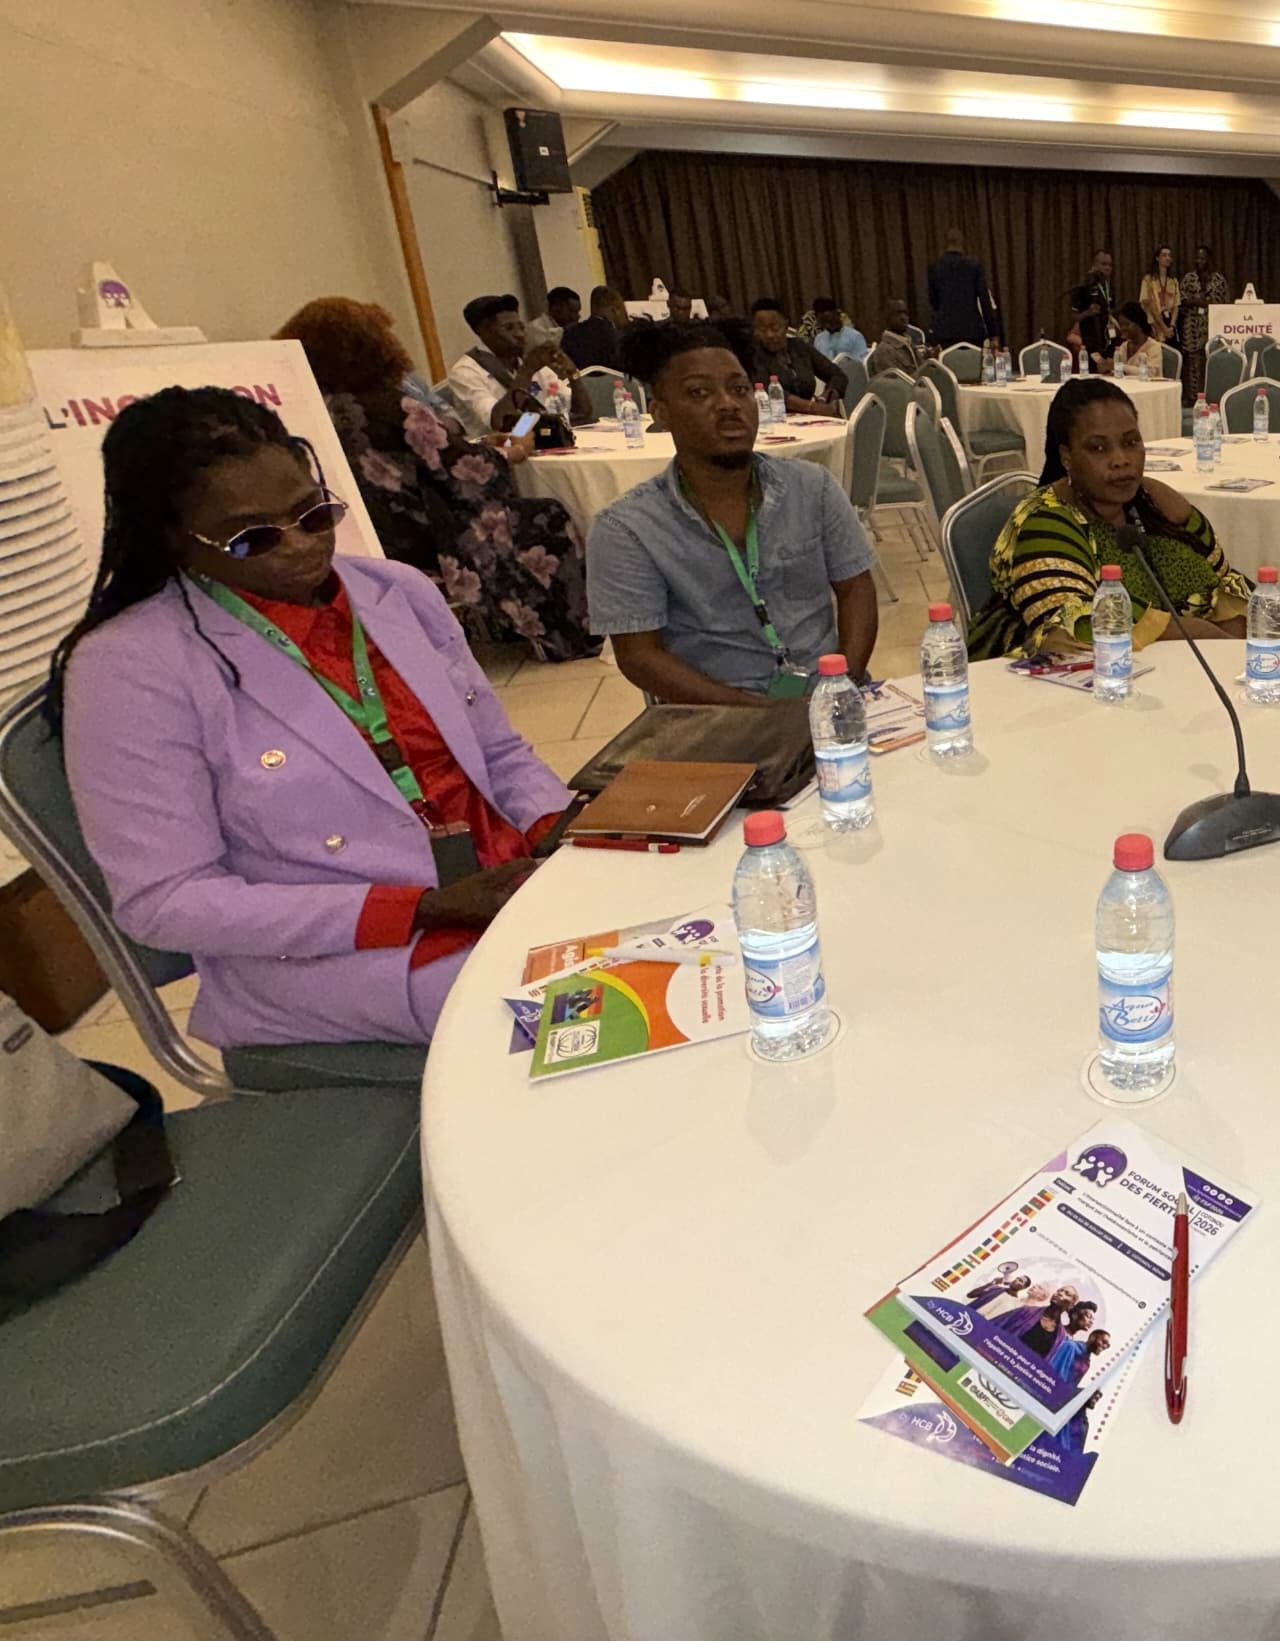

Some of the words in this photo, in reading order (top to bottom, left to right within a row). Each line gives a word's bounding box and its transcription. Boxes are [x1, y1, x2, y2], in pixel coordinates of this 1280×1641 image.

[1223, 322, 1273, 334] DIGNITÉ
[1119, 1177, 1143, 1196] DES
[1142, 1191, 1179, 1218] FIERT
[1127, 1170, 1161, 1194] FORUM
[1160, 1189, 1196, 1215] SOCL
[1193, 1216, 1219, 1236] 2026
[935, 1307, 954, 1322] HCB
[911, 1417, 933, 1429] HCB
